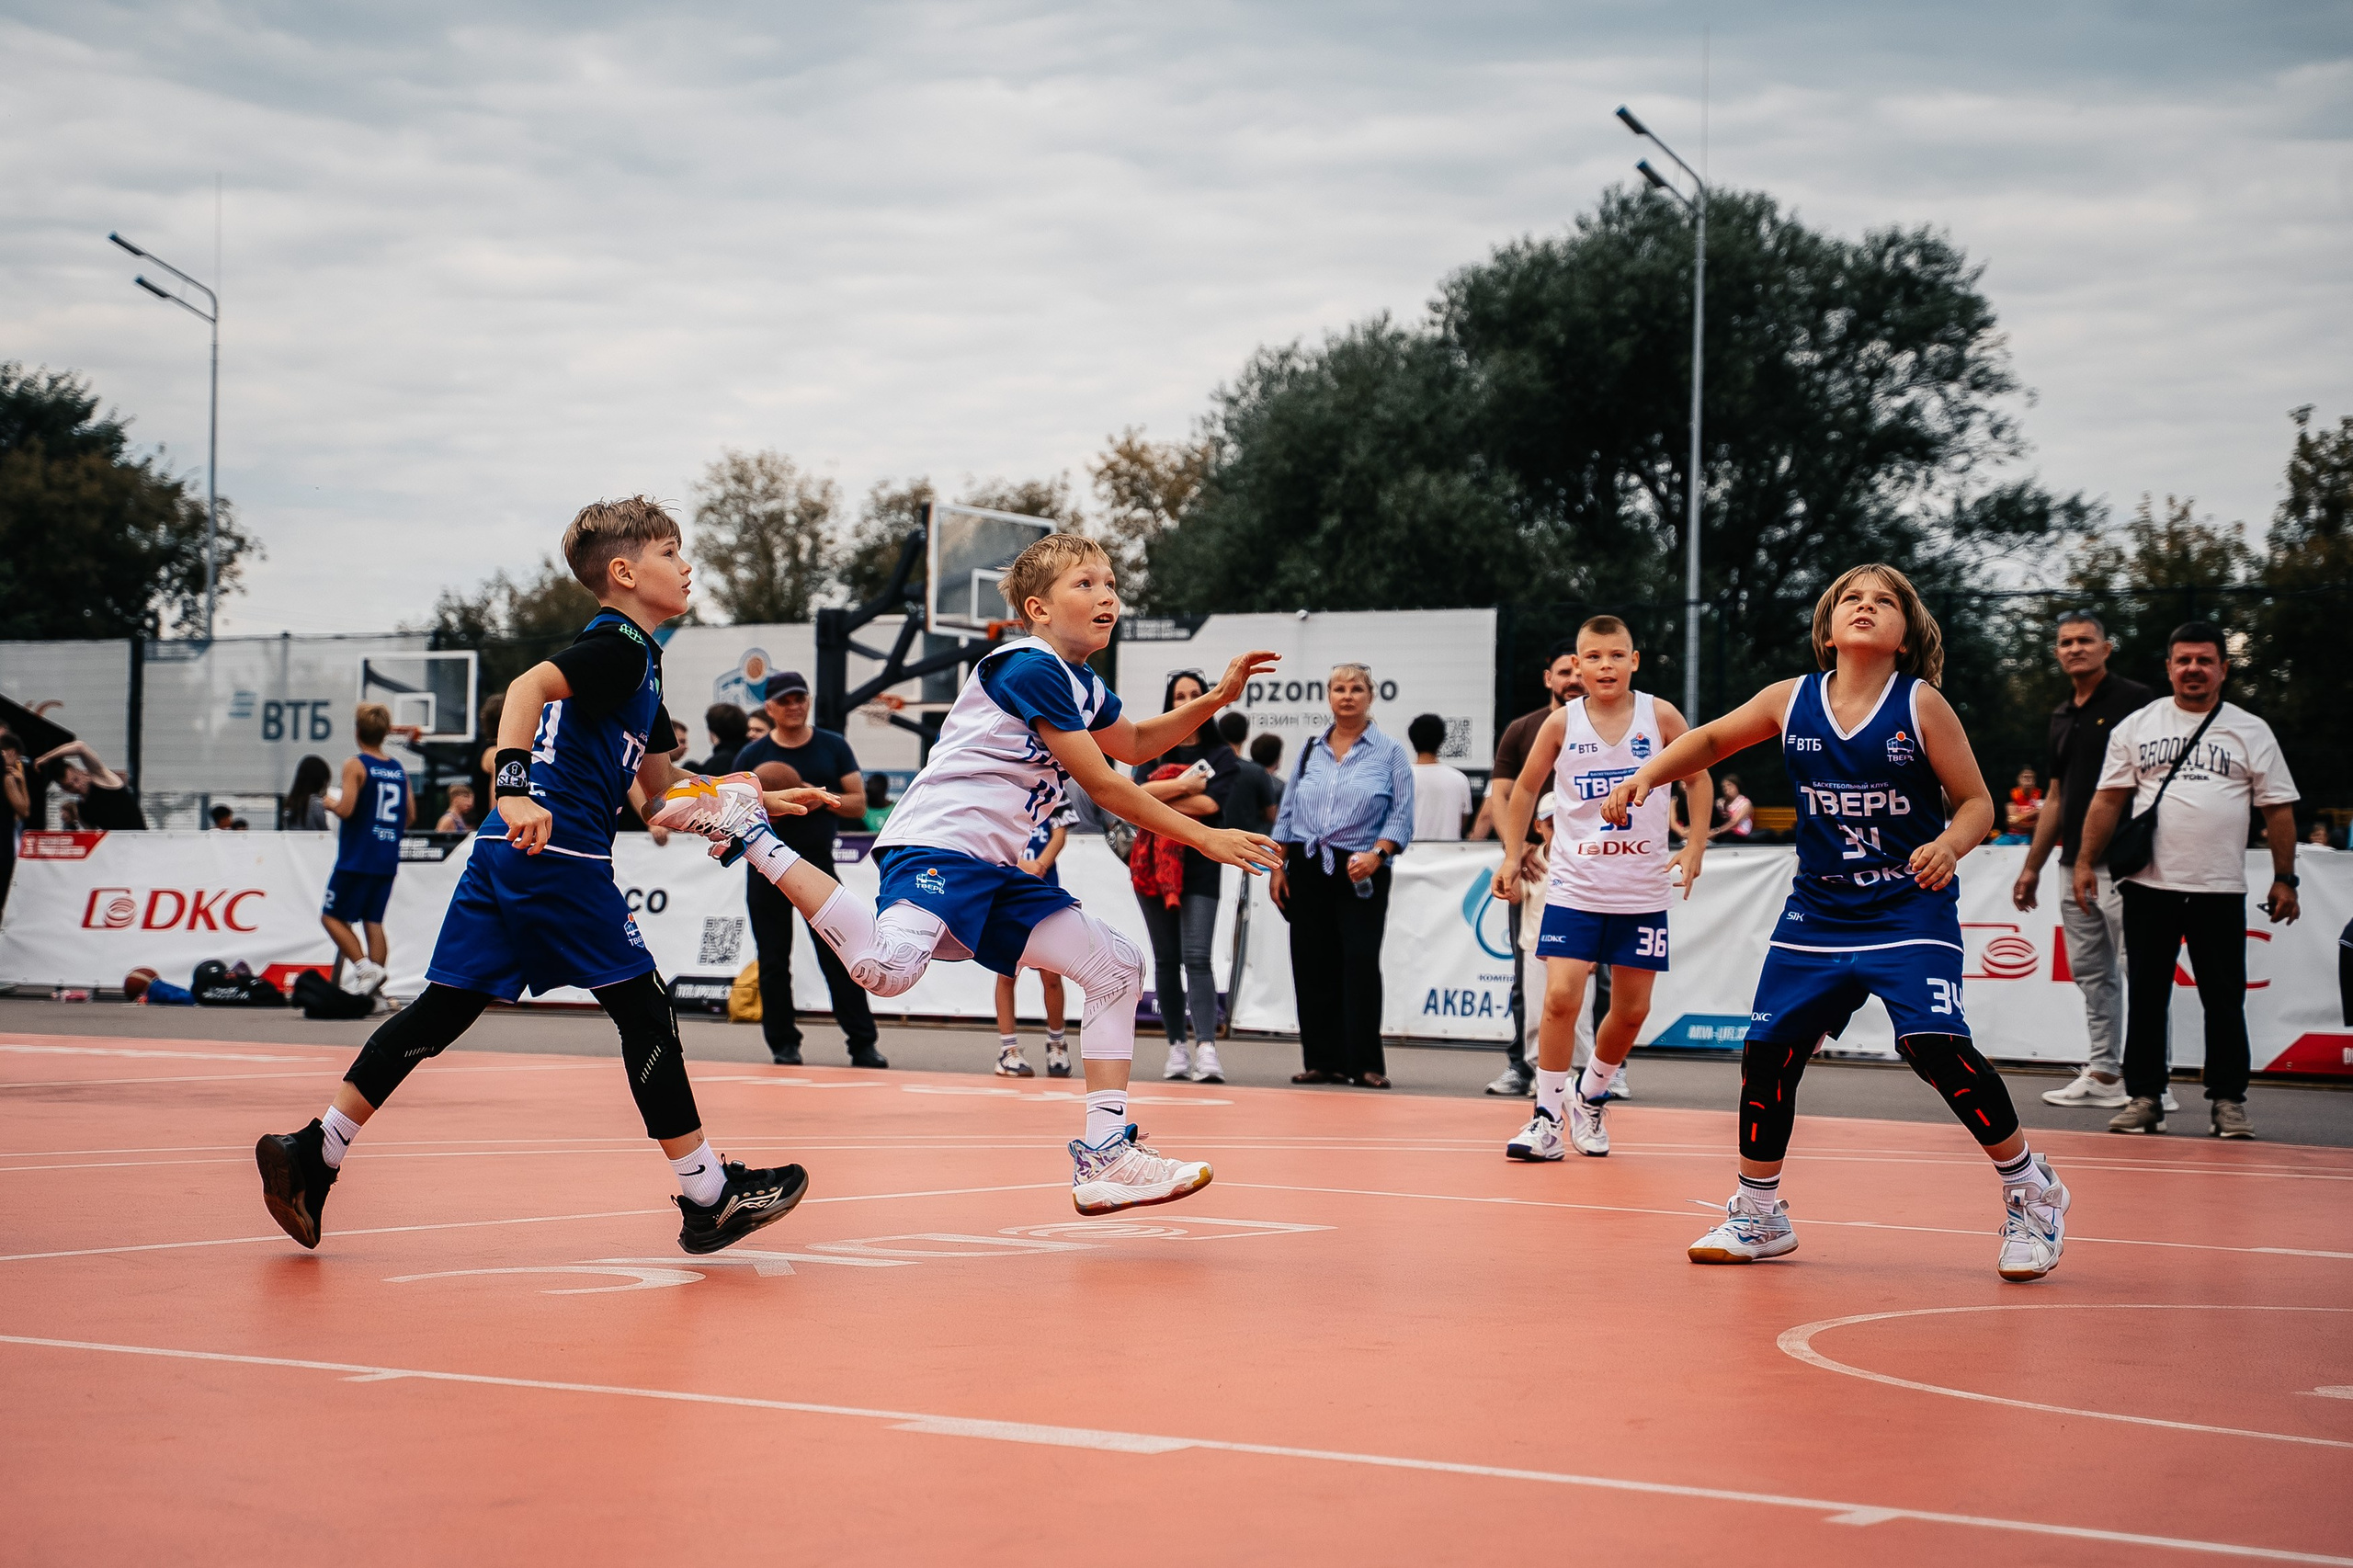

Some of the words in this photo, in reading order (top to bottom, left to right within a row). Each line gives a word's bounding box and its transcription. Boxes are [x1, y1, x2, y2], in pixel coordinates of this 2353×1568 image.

[263, 701, 332, 741] ВТБ
[1578, 743, 1598, 754] ВТБ
[1796, 738, 1823, 752] ВТБ
[1887, 754, 1915, 763] ТВЕРЬ
[1576, 777, 1625, 800] ТВЕ
[1813, 781, 1869, 790] БАСКЕТБОЛЬНЫЙ
[377, 781, 401, 823] 12
[1800, 786, 1912, 816] ТВЕРЬ
[1603, 840, 1652, 856] DKC
[915, 882, 945, 894] ТВЕРЬ
[140, 888, 267, 932] DKC
[1635, 926, 1668, 958] 36
[1478, 974, 1516, 983] КОМП
